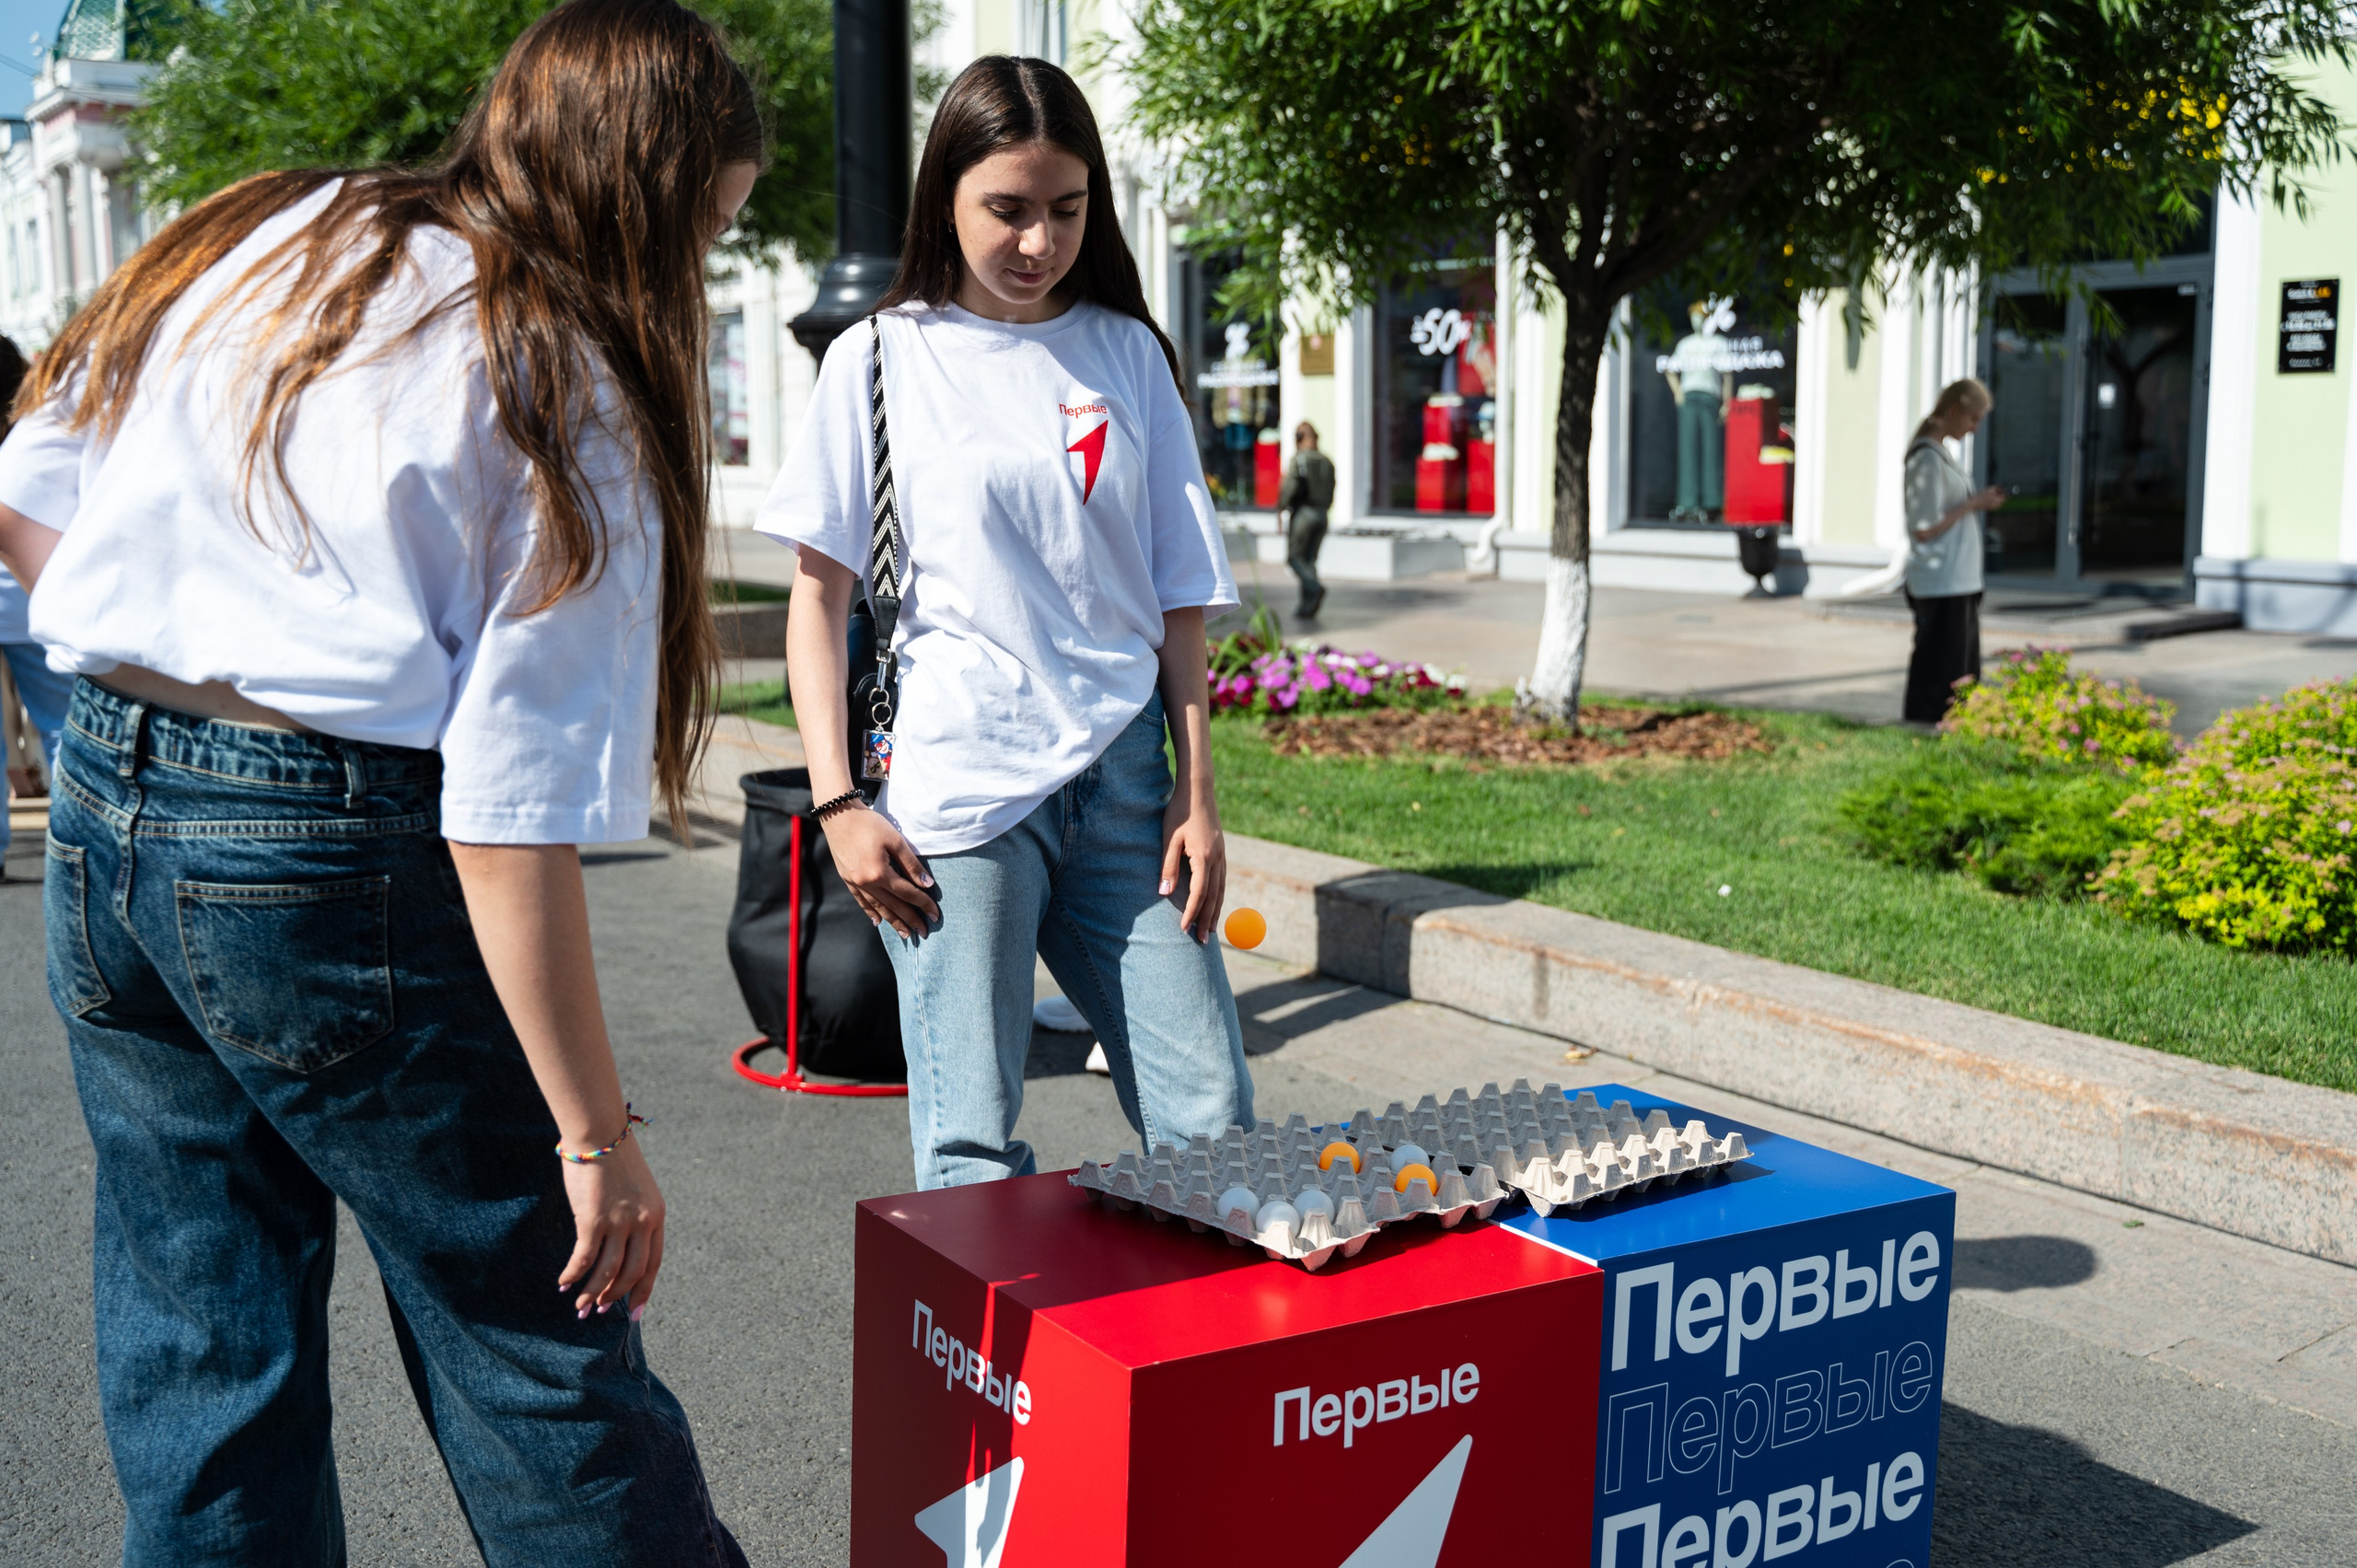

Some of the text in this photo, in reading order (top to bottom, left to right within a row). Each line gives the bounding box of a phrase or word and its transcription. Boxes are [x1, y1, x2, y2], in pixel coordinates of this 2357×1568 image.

[1059, 403, 1108, 419] Первые
[912, 1299, 1032, 1425] Первые
[1611, 1230, 1940, 1377] Первые
[1273, 1363, 1480, 1448] Первые
[1604, 1341, 1933, 1495] Первые
[1600, 1451, 1924, 1568] Первые
